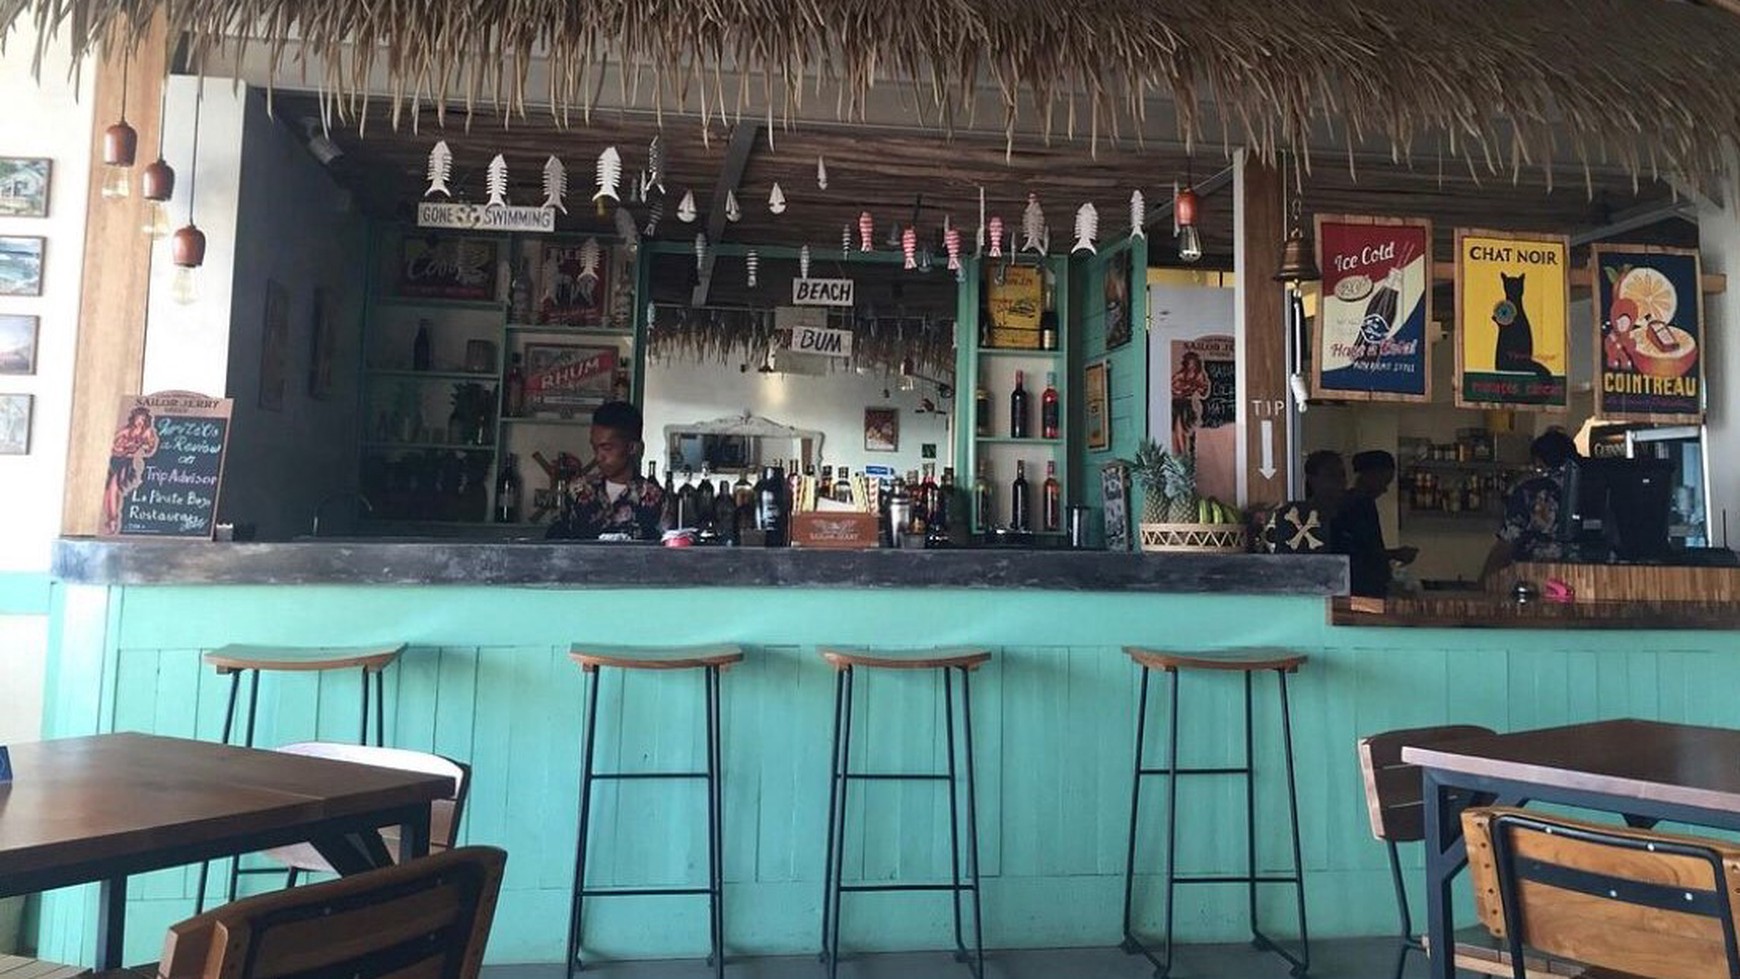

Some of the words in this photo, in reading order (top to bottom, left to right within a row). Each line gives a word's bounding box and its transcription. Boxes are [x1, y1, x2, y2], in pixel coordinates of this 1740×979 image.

[423, 206, 454, 223] GONE
[484, 208, 550, 228] SWIMMING
[1334, 254, 1358, 272] Ice
[1361, 241, 1395, 266] Cold
[1469, 246, 1512, 263] CHAT
[1516, 250, 1558, 266] NOIR
[797, 282, 851, 302] BEACH
[800, 329, 842, 353] BUM
[541, 357, 600, 389] RHUM
[1603, 371, 1697, 397] COINTREAU
[135, 397, 178, 407] SAILOR
[180, 399, 220, 410] JERRY
[1251, 400, 1285, 416] TIP
[173, 435, 222, 454] Review
